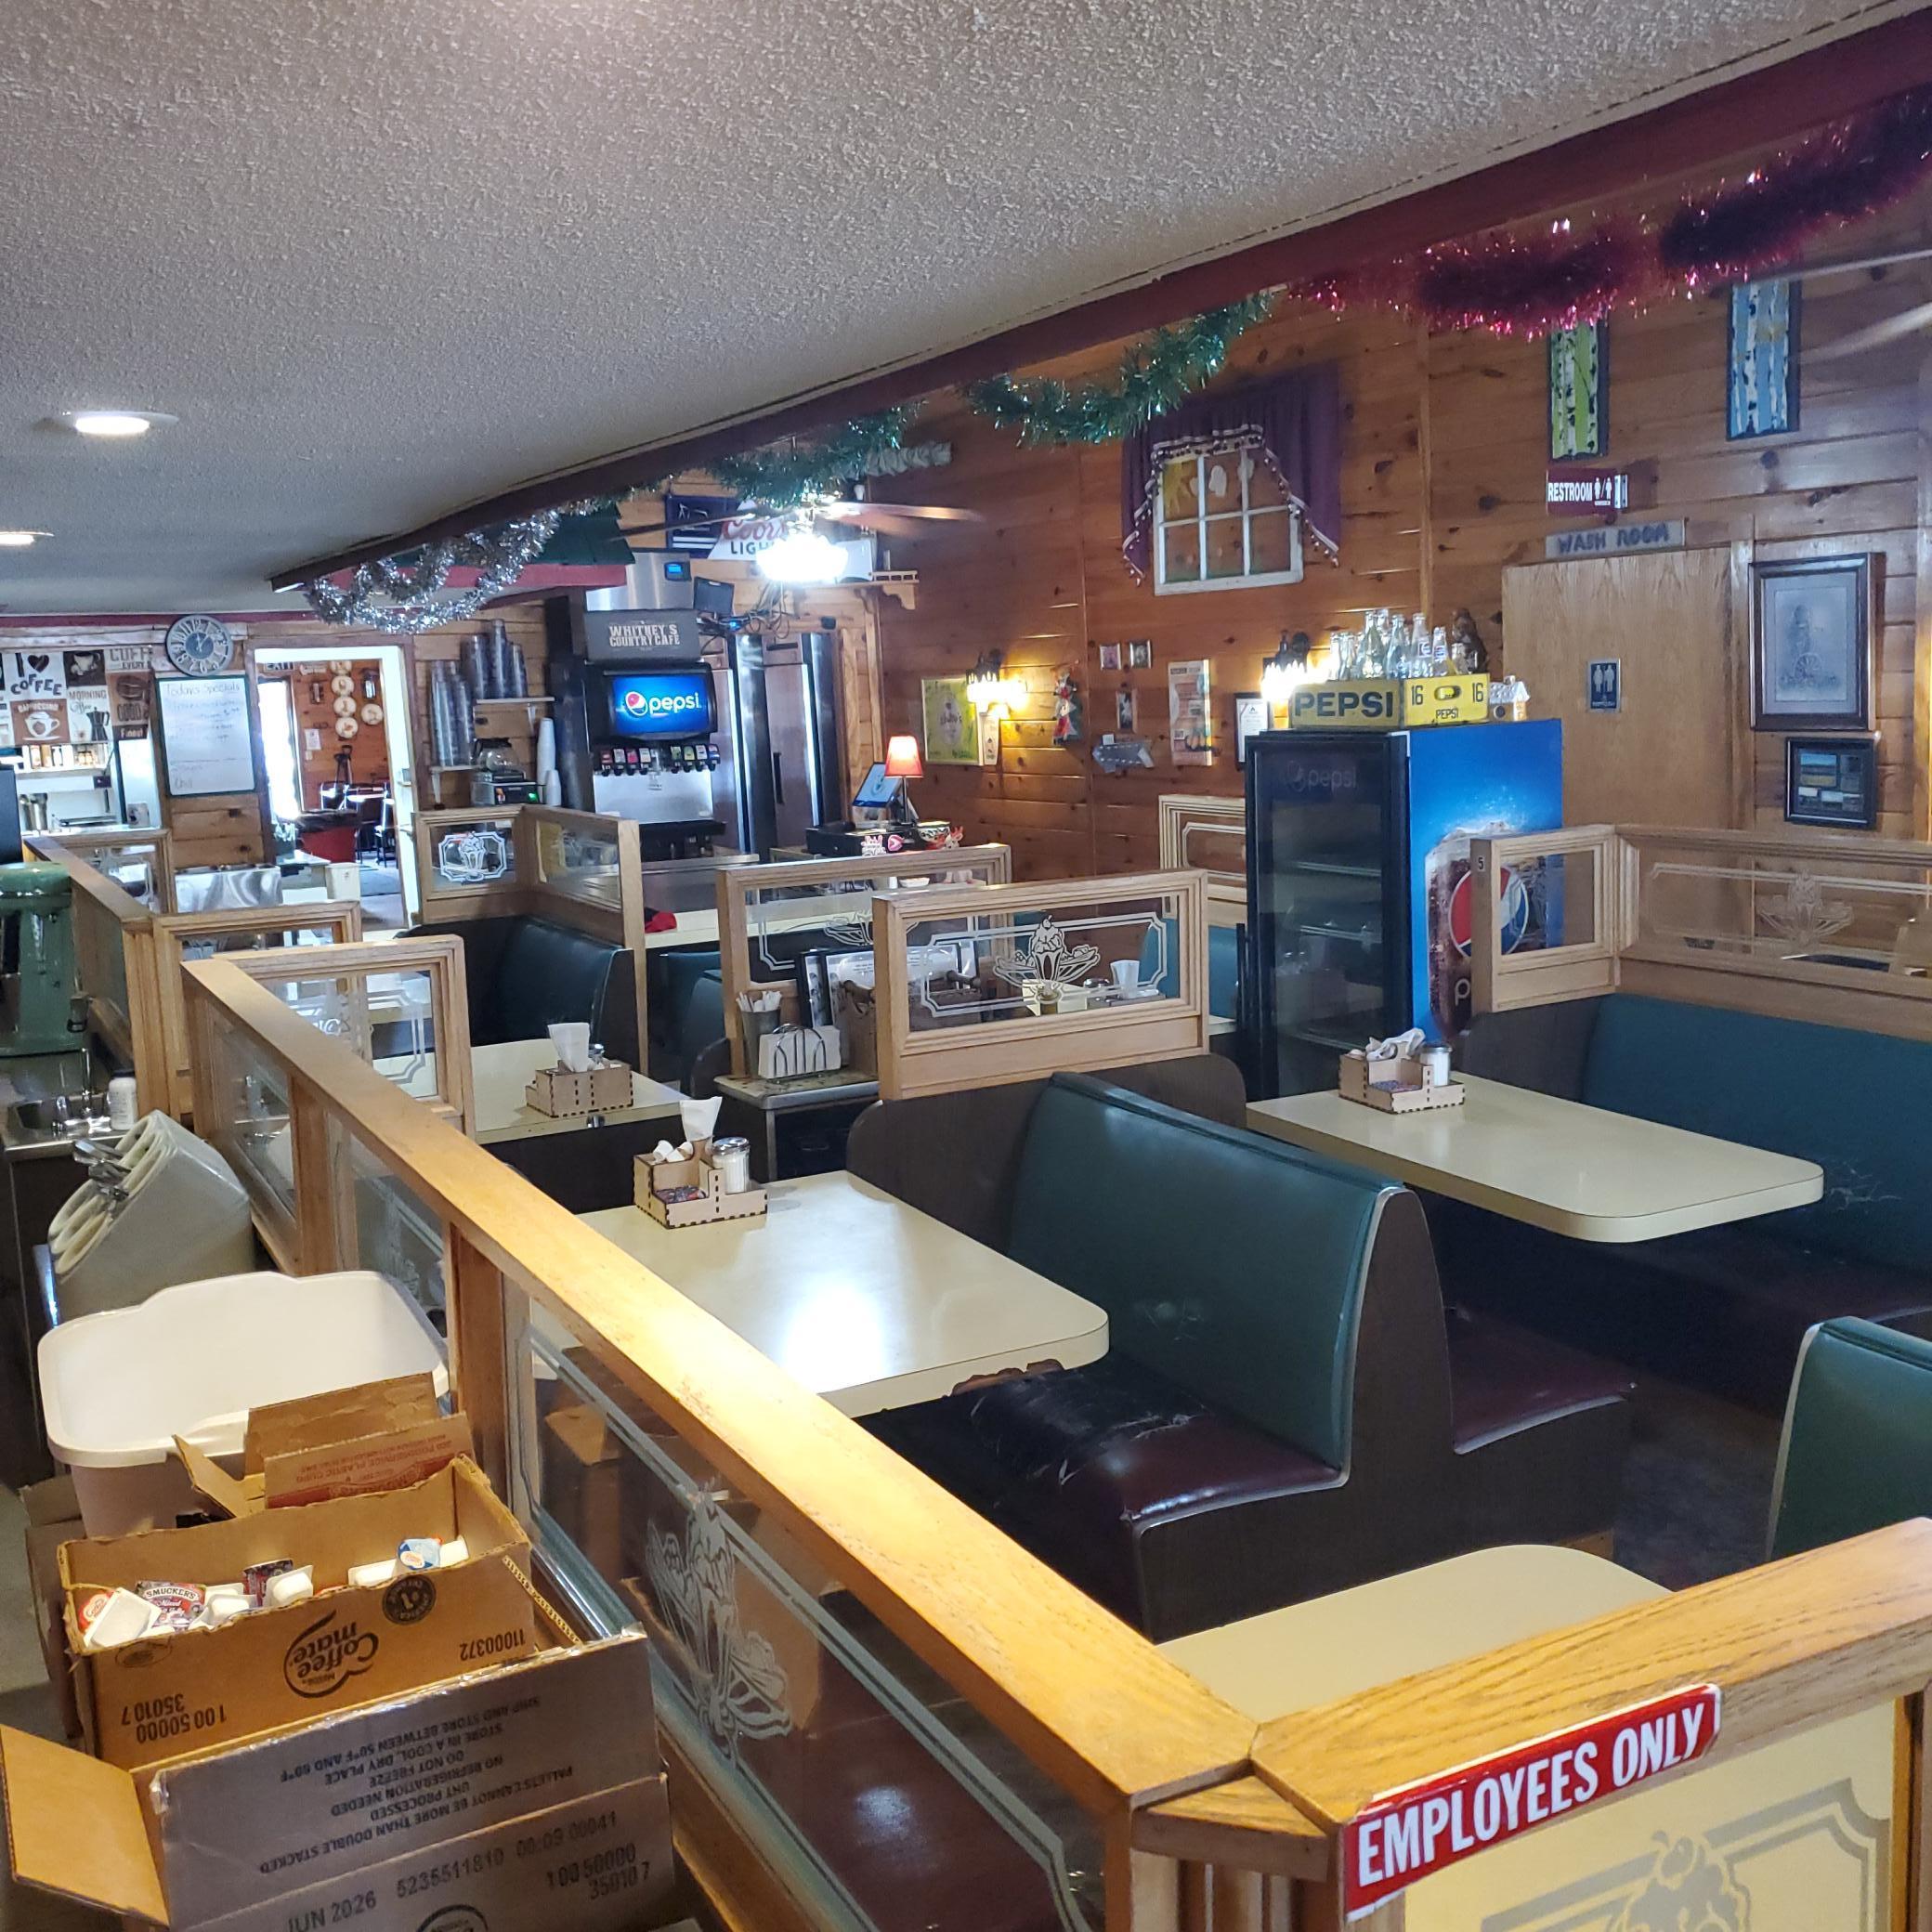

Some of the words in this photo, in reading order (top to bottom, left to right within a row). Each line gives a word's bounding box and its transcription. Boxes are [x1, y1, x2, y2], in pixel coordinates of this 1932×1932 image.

[1548, 482, 1592, 502] RESTROOM
[722, 517, 789, 541] Coors
[1558, 531, 1606, 555] WASH
[1617, 522, 1669, 547] ROOM
[730, 542, 777, 555] LIGH
[609, 634, 652, 647] COUNTRY
[653, 634, 681, 646] CAFE
[15, 652, 25, 678] I
[10, 673, 62, 696] COFFEE
[69, 689, 108, 700] MORNING
[1472, 682, 1484, 704] 16
[649, 692, 701, 713] pepsi
[1294, 691, 1393, 718] PEPSI
[1411, 685, 1423, 706] 16
[1435, 708, 1459, 720] PEPSI
[1308, 765, 1358, 790] pepsi
[1478, 856, 1484, 871] 5
[459, 1629, 526, 1661] 11000372
[294, 1631, 379, 1684] Coffee
[133, 1692, 185, 1722] 35010
[442, 1713, 479, 1732] STORE
[466, 1723, 502, 1742] STORE
[378, 1725, 438, 1752] BETWEEN
[448, 1735, 461, 1746] IN
[314, 1754, 343, 1770] AND
[368, 1755, 394, 1770] DRY
[417, 1756, 443, 1772] NOT
[446, 1750, 463, 1763] DO
[485, 1755, 503, 1769] NO
[324, 1763, 364, 1783] PLACE
[369, 1765, 414, 1787] FREEZE
[385, 1761, 482, 1799] REFRIGERATION
[331, 1792, 383, 1816] NEEDED
[471, 1782, 521, 1805] CANNOT
[1358, 1741, 1599, 1887] EMPLOYEES
[1612, 1703, 1705, 1788] ONLY
[370, 1790, 442, 1821] PROCESSED
[414, 1805, 450, 1823] MORE
[451, 1798, 468, 1811] BE
[375, 1817, 411, 1836] THAN
[321, 1829, 372, 1853] DOUBLE
[259, 1846, 320, 1873] STACKED
[332, 1889, 377, 1924] 2026
